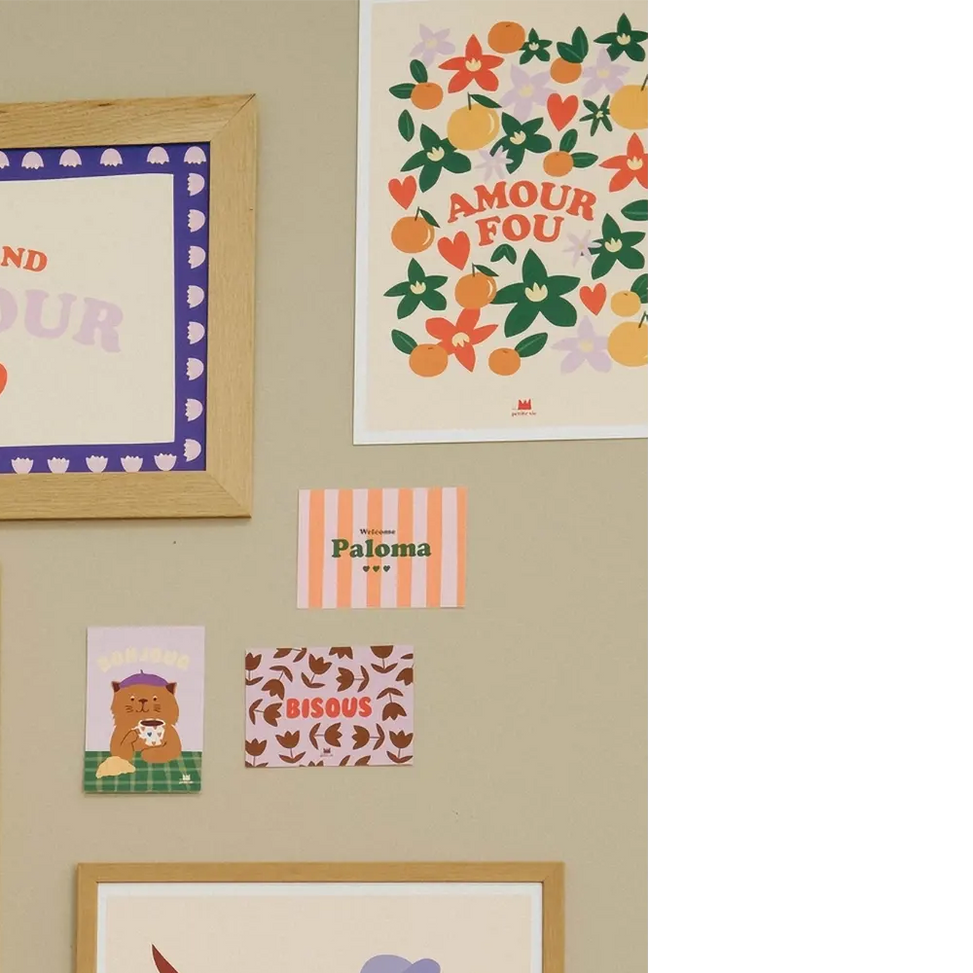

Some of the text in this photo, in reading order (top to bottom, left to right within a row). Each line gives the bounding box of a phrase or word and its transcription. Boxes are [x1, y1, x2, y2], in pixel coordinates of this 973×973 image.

[447, 180, 597, 223] AMOUR
[475, 213, 565, 247] FOU
[331, 538, 432, 558] Paloma
[286, 696, 373, 718] BISOUS
